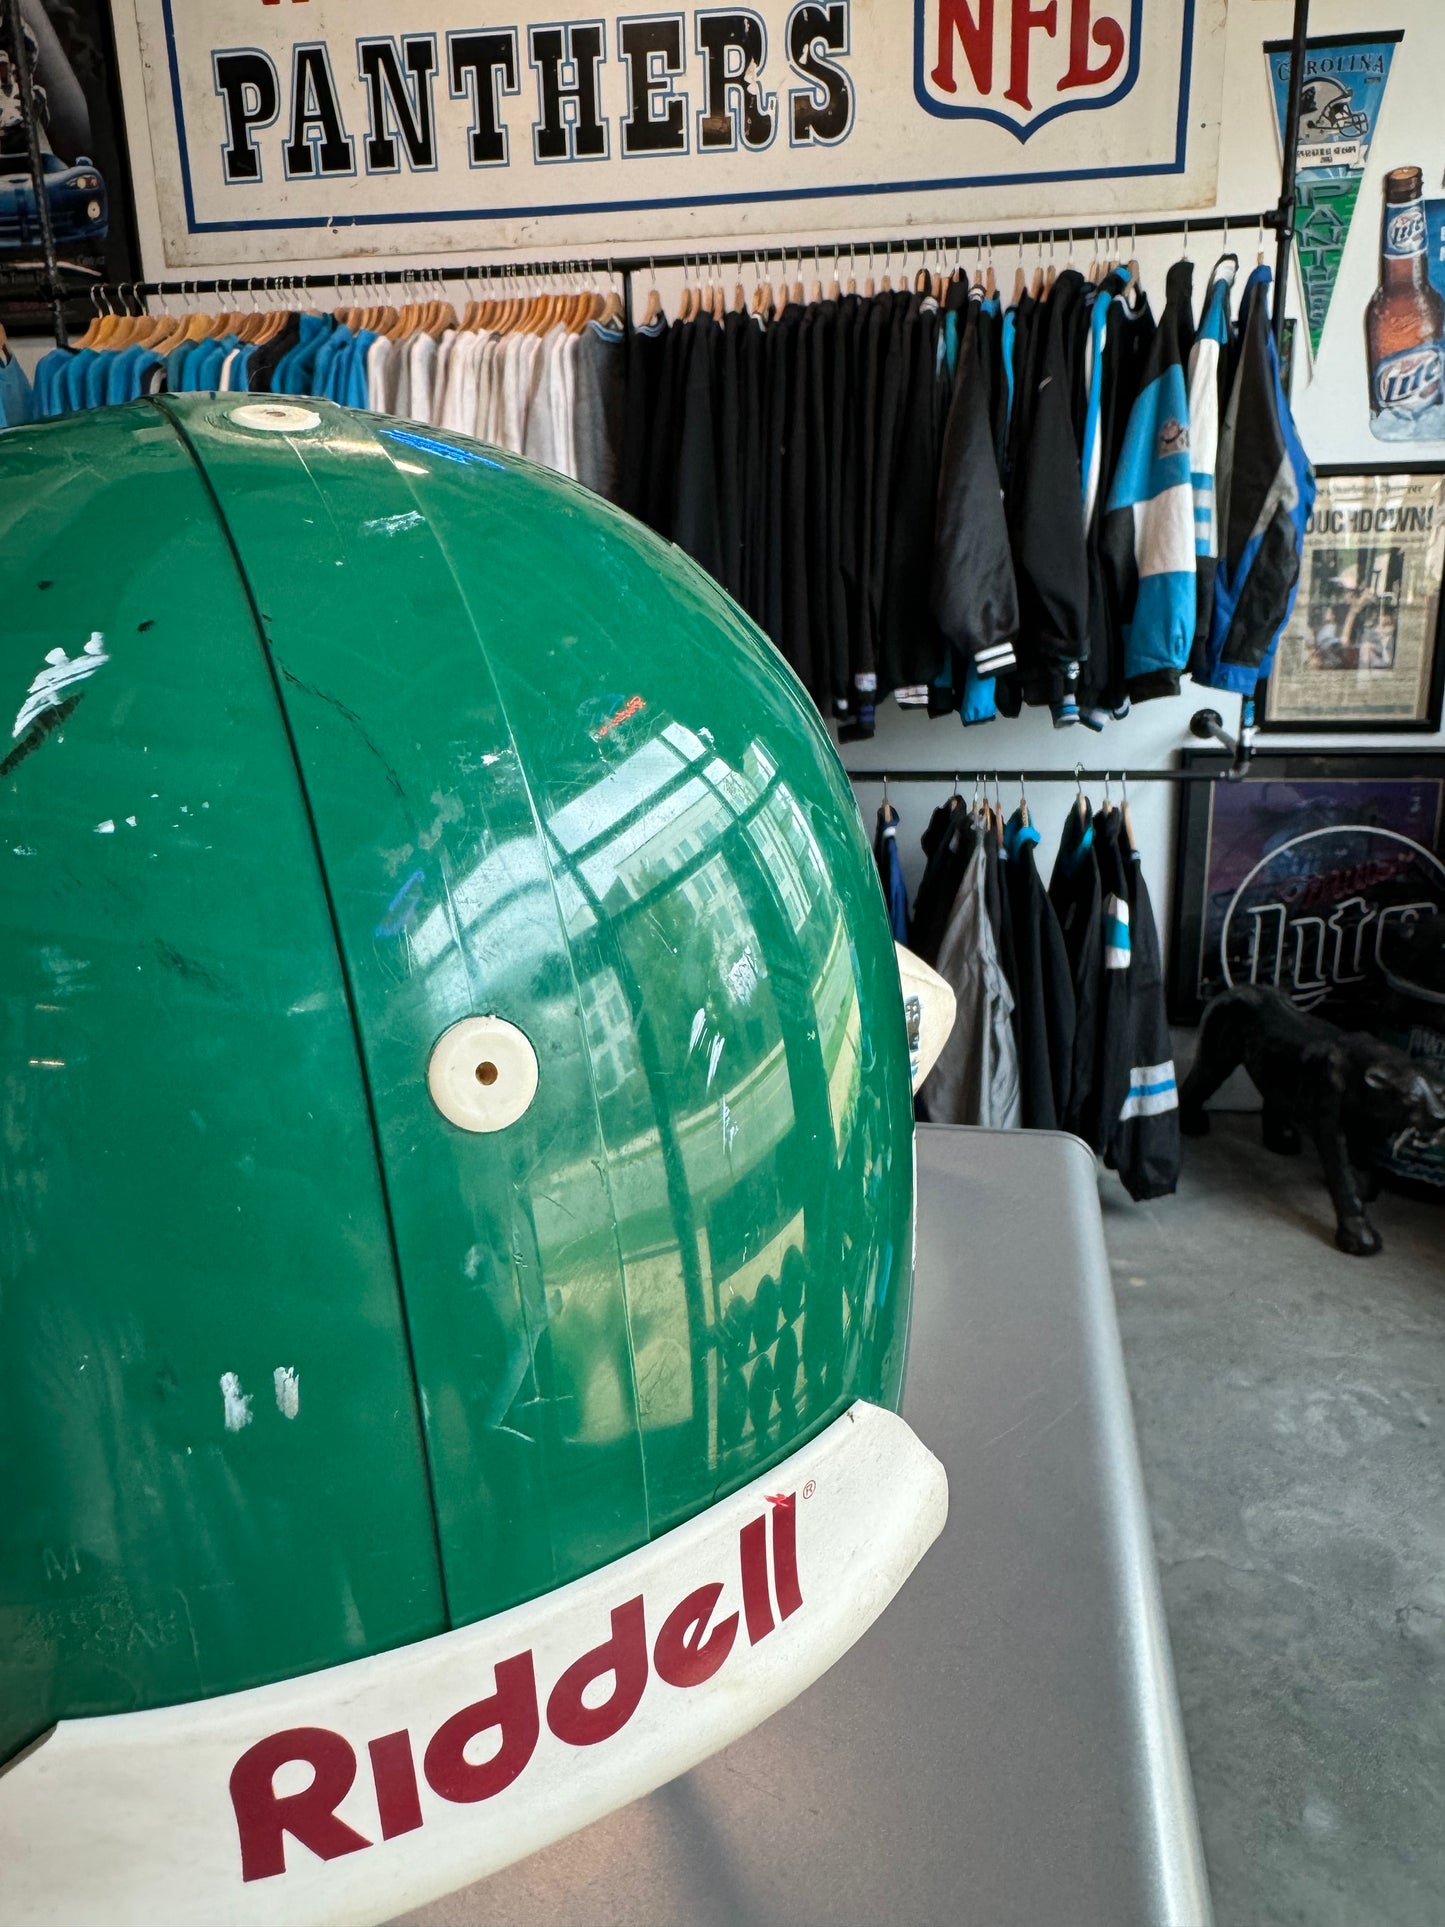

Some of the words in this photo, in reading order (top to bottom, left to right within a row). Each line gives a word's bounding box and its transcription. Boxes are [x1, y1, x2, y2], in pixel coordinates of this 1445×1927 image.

[212, 1, 856, 184] PANTHERS
[931, 0, 1126, 111] NFL
[1278, 55, 1384, 81] CROLINA
[1304, 504, 1434, 534] OUCHDOWN!
[229, 1491, 804, 1883] Riddell
